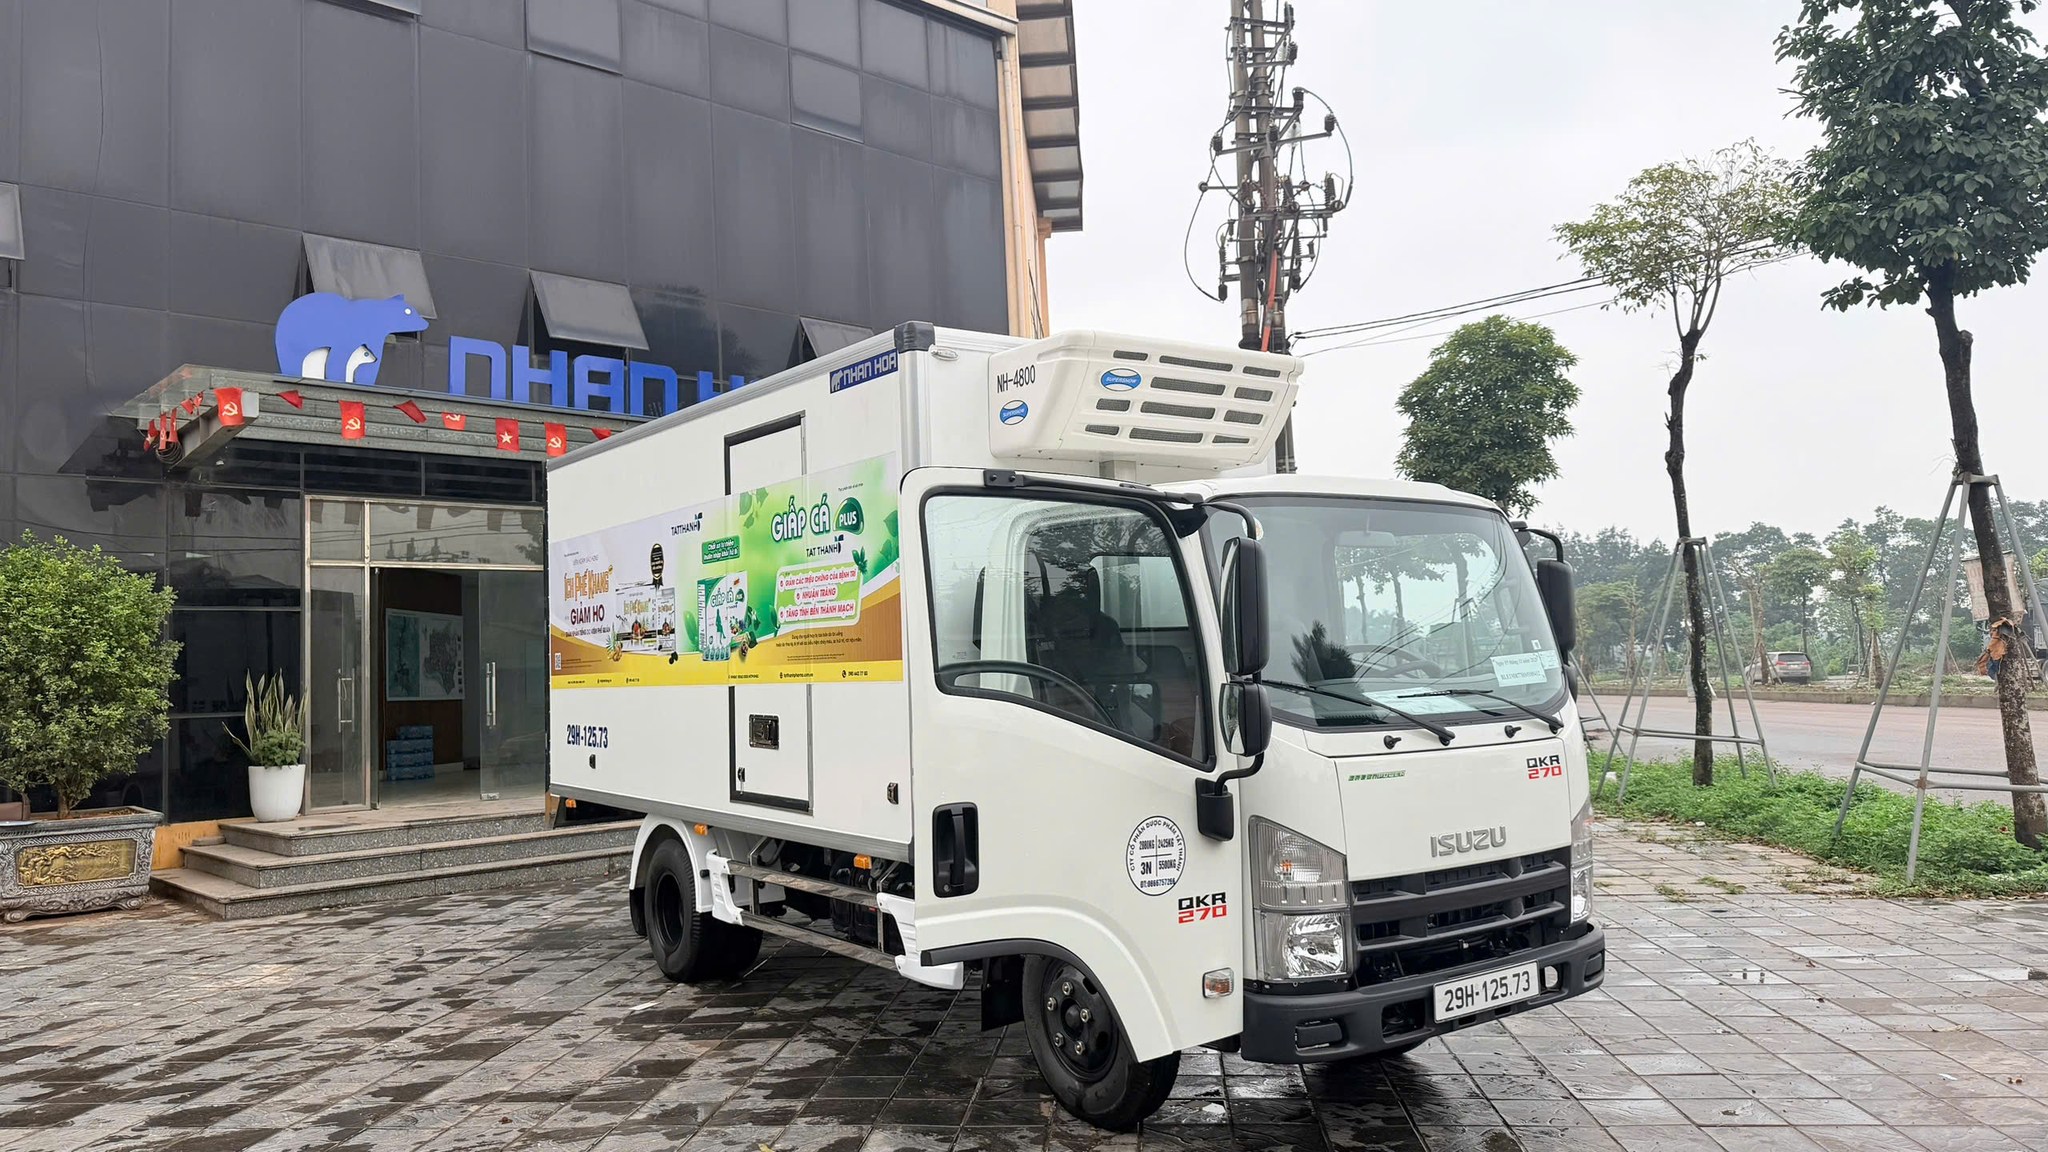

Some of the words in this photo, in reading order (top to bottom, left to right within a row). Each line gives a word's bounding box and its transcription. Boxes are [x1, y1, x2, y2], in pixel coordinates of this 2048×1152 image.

[843, 361, 872, 386] NHAN
[874, 352, 897, 375] HOA
[996, 364, 1036, 394] NH-4800
[809, 493, 831, 535] CÁ
[839, 510, 858, 527] PLUS
[570, 601, 591, 625] GIẢM
[592, 604, 605, 622] HO
[567, 724, 608, 748] 29H-125.73
[1526, 755, 1561, 769] QKR
[1528, 766, 1562, 780] 270
[1430, 825, 1507, 857] ISUZU
[1140, 861, 1152, 875] 3N
[1178, 892, 1226, 911] QKR
[1178, 904, 1227, 924] 270
